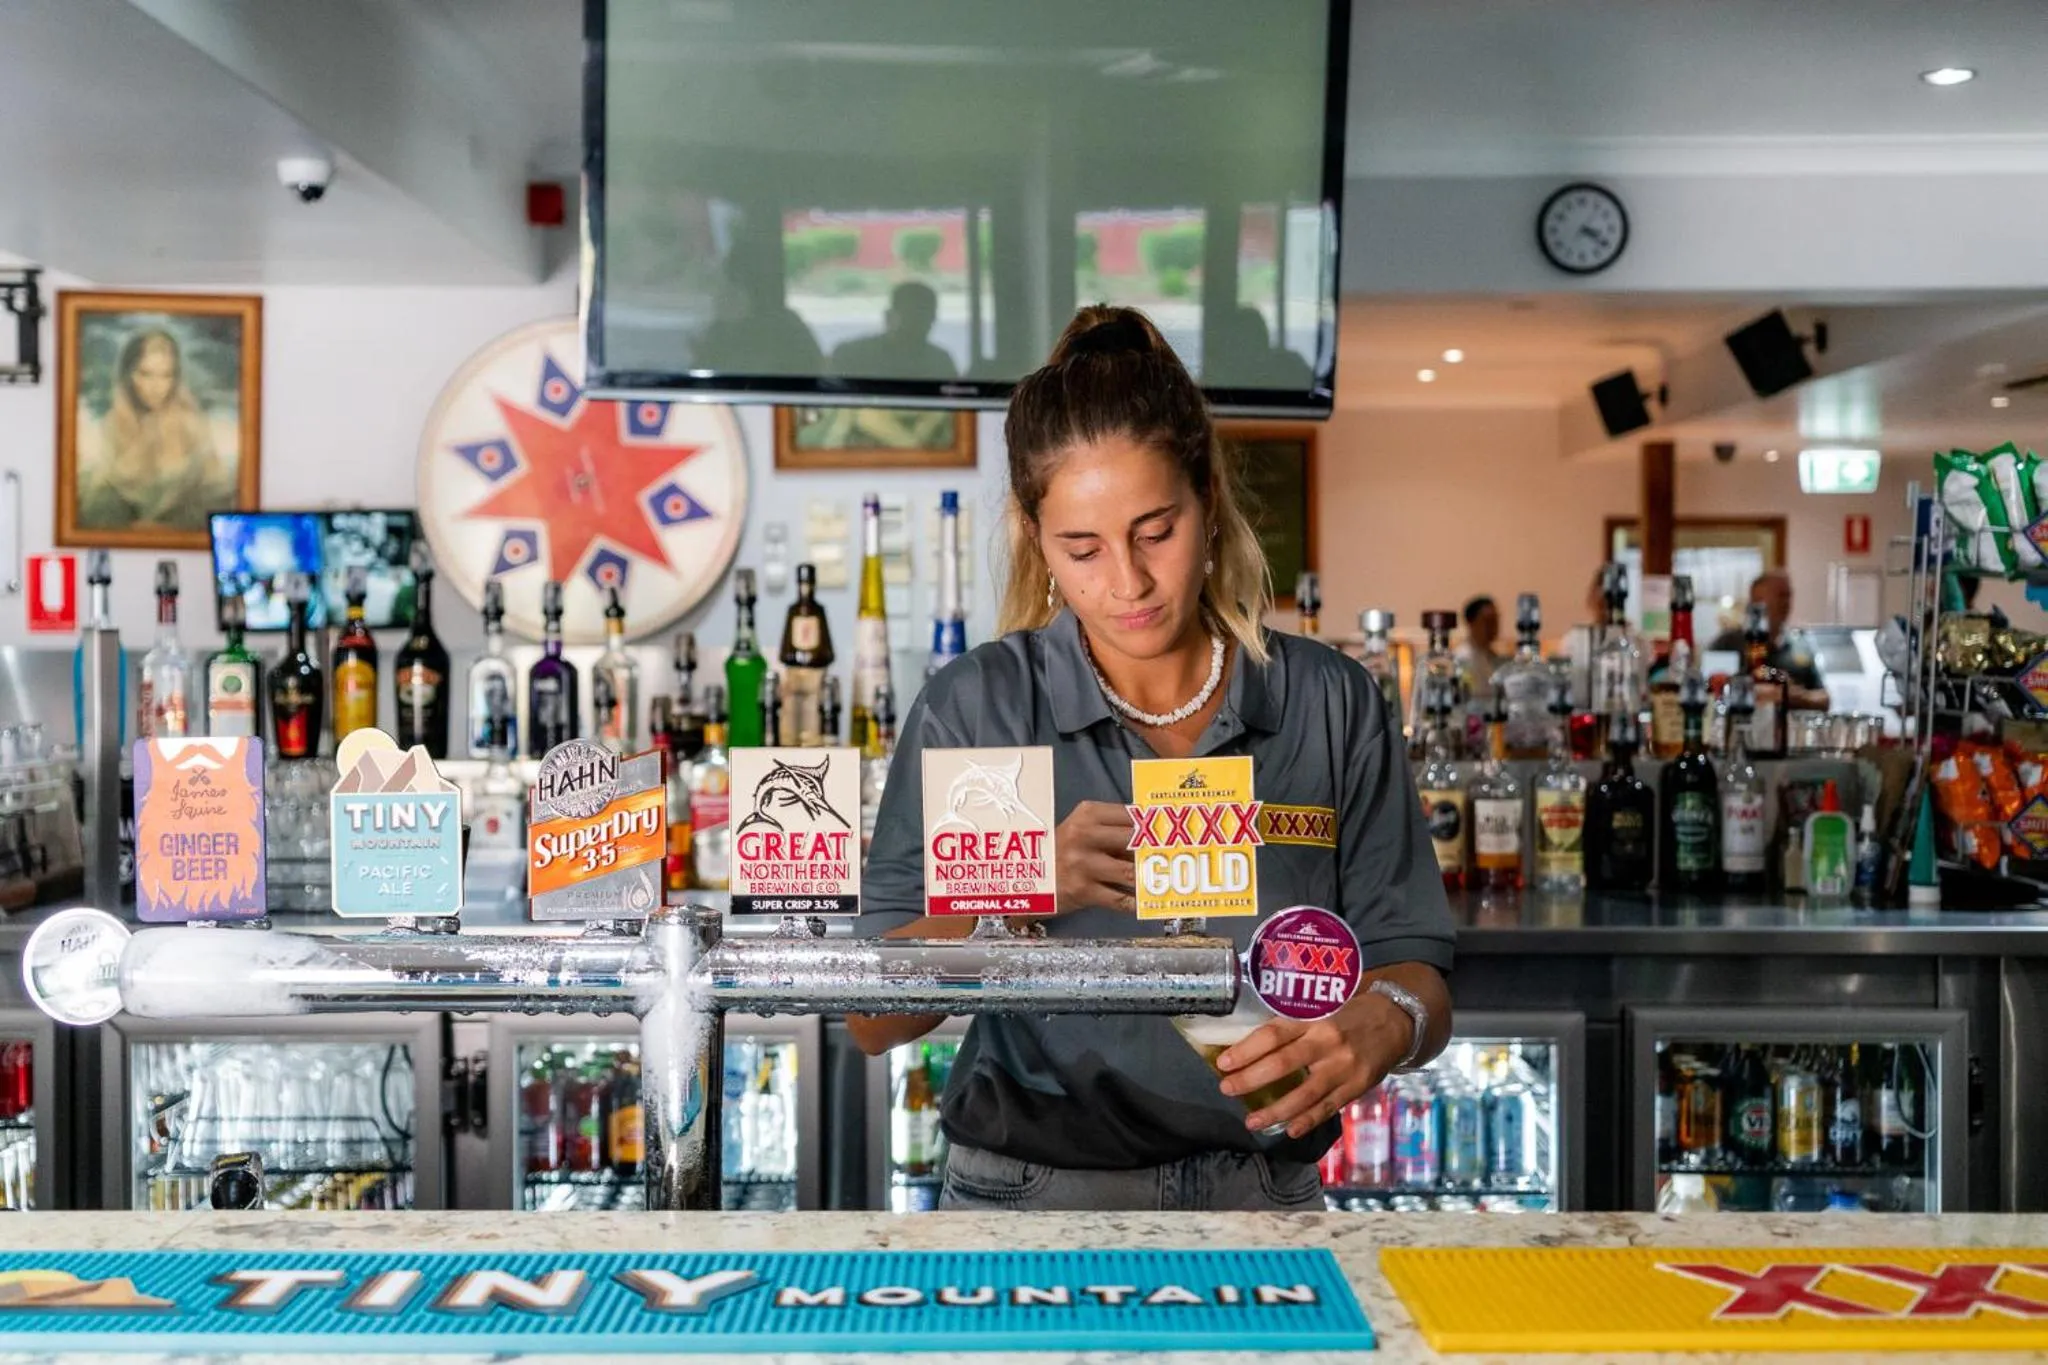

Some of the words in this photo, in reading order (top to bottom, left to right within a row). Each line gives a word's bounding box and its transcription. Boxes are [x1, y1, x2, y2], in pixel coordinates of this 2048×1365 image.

[170, 779, 228, 801] James
[538, 756, 617, 801] HAHN
[170, 799, 228, 819] Squire
[343, 801, 448, 833] TINY
[534, 805, 660, 869] SuperDry
[1126, 801, 1264, 850] XXXX
[1266, 811, 1333, 841] XXXX
[159, 832, 240, 857] GINGER
[736, 831, 851, 861] GREAT
[931, 831, 1046, 861] GREAT
[172, 858, 228, 881] BEER
[359, 864, 433, 879] PACIFIC
[739, 863, 850, 880] NORTHERN
[935, 862, 1045, 881] NORTHERN
[1142, 851, 1251, 896] GOLD
[378, 882, 415, 896] ALE
[750, 882, 812, 894] BREWING
[945, 881, 1009, 894] BREWING
[752, 900, 783, 910] SUPER
[785, 900, 812, 910] CRISP
[814, 900, 839, 910] 3.5%
[950, 900, 1002, 911] ORIGINAL
[1004, 899, 1031, 909] 4.2%
[1260, 939, 1353, 976] XXXX
[1260, 969, 1346, 1003] BITTER
[212, 1269, 758, 1314] TINY
[776, 1284, 1320, 1307] MOUNTAIN
